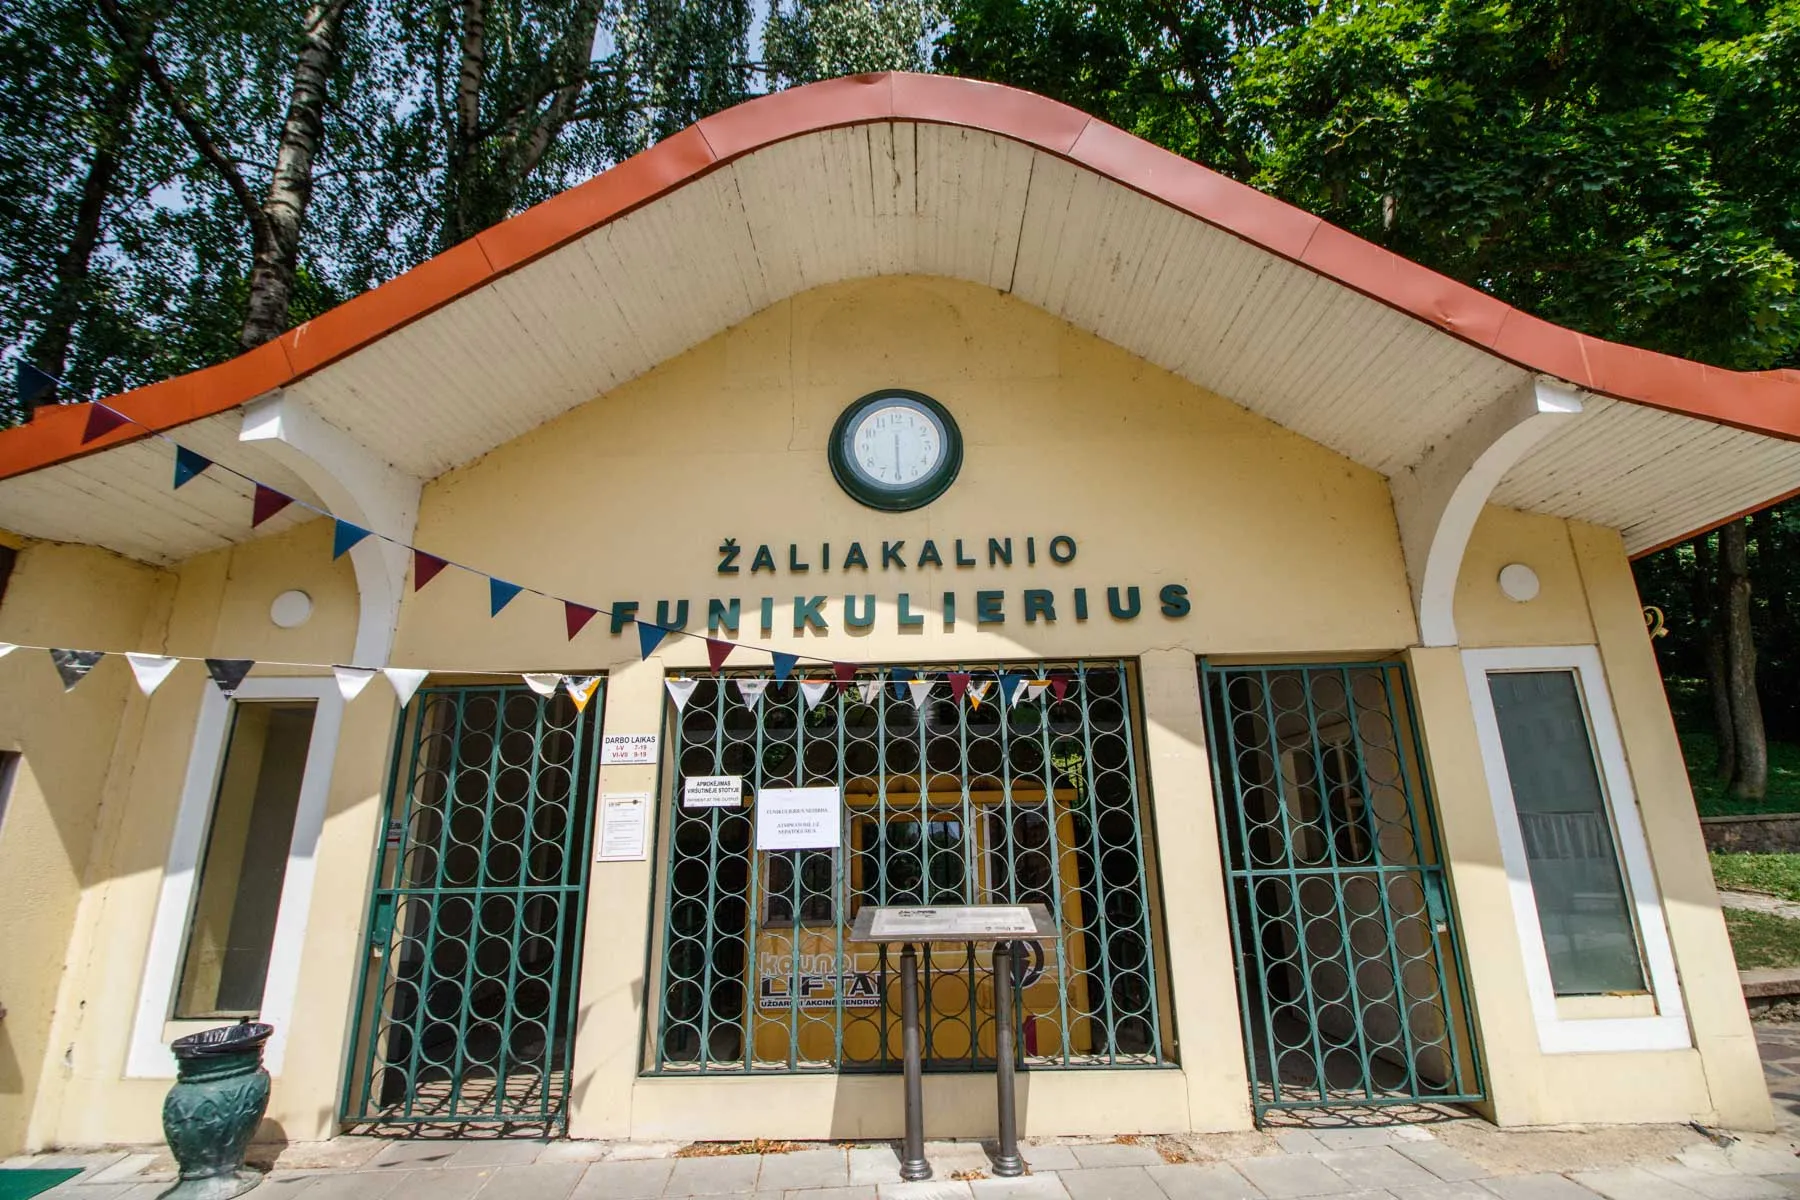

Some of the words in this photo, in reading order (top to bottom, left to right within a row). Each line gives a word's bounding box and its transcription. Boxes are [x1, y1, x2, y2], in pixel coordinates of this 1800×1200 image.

[716, 535, 1077, 574] ŽALIAKALNIO
[610, 584, 1191, 634] FUNIKULIERIUS
[605, 736, 630, 744] DARBO
[631, 735, 656, 743] LAIKAS
